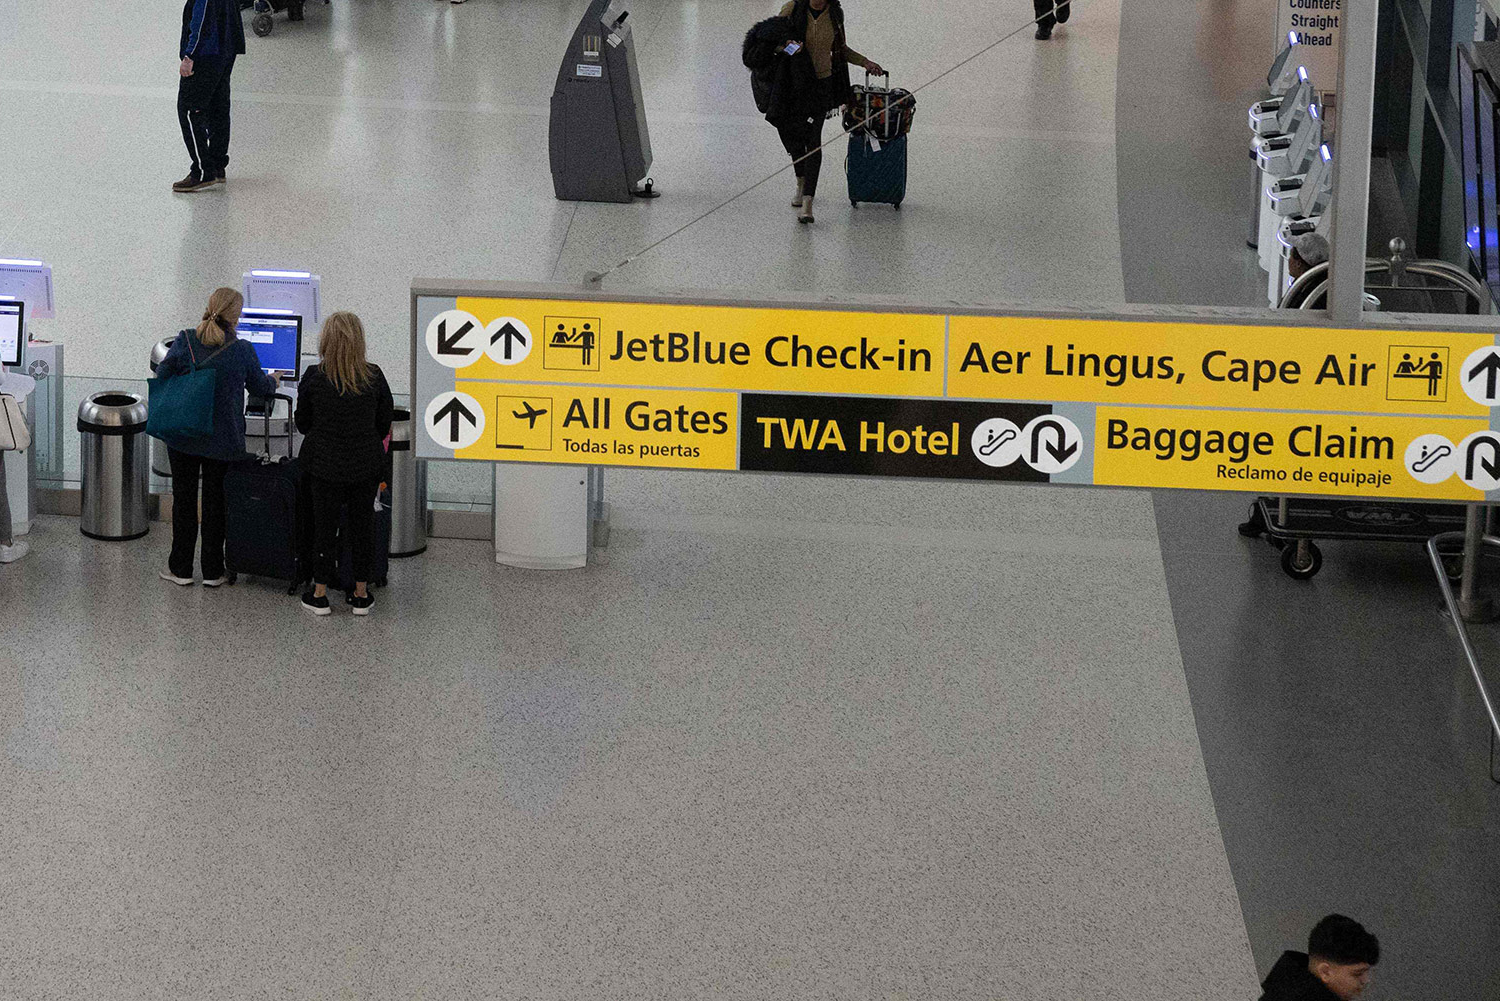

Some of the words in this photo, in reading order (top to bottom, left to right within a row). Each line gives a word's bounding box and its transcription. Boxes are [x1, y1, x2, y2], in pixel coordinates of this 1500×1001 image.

[1291, 13, 1339, 31] Straight
[1297, 32, 1332, 46] Ahead
[610, 331, 751, 365] JetBlue
[765, 335, 931, 371] Check-in
[958, 343, 1031, 374] Aer
[1046, 344, 1185, 387] Lingus,
[1202, 351, 1301, 392] Cape
[1315, 354, 1376, 387] Air
[563, 398, 611, 430] All
[625, 401, 728, 435] Gates
[563, 439, 607, 455] Todas
[614, 440, 633, 454] las
[640, 442, 700, 459] puertas
[757, 417, 846, 451] TWA
[860, 421, 960, 456] Hotel
[1108, 419, 1274, 468] Baggage
[1289, 425, 1394, 460] Claim
[1217, 464, 1287, 481] Reclamo
[1293, 467, 1312, 481] de
[1319, 469, 1392, 488] equipaje
